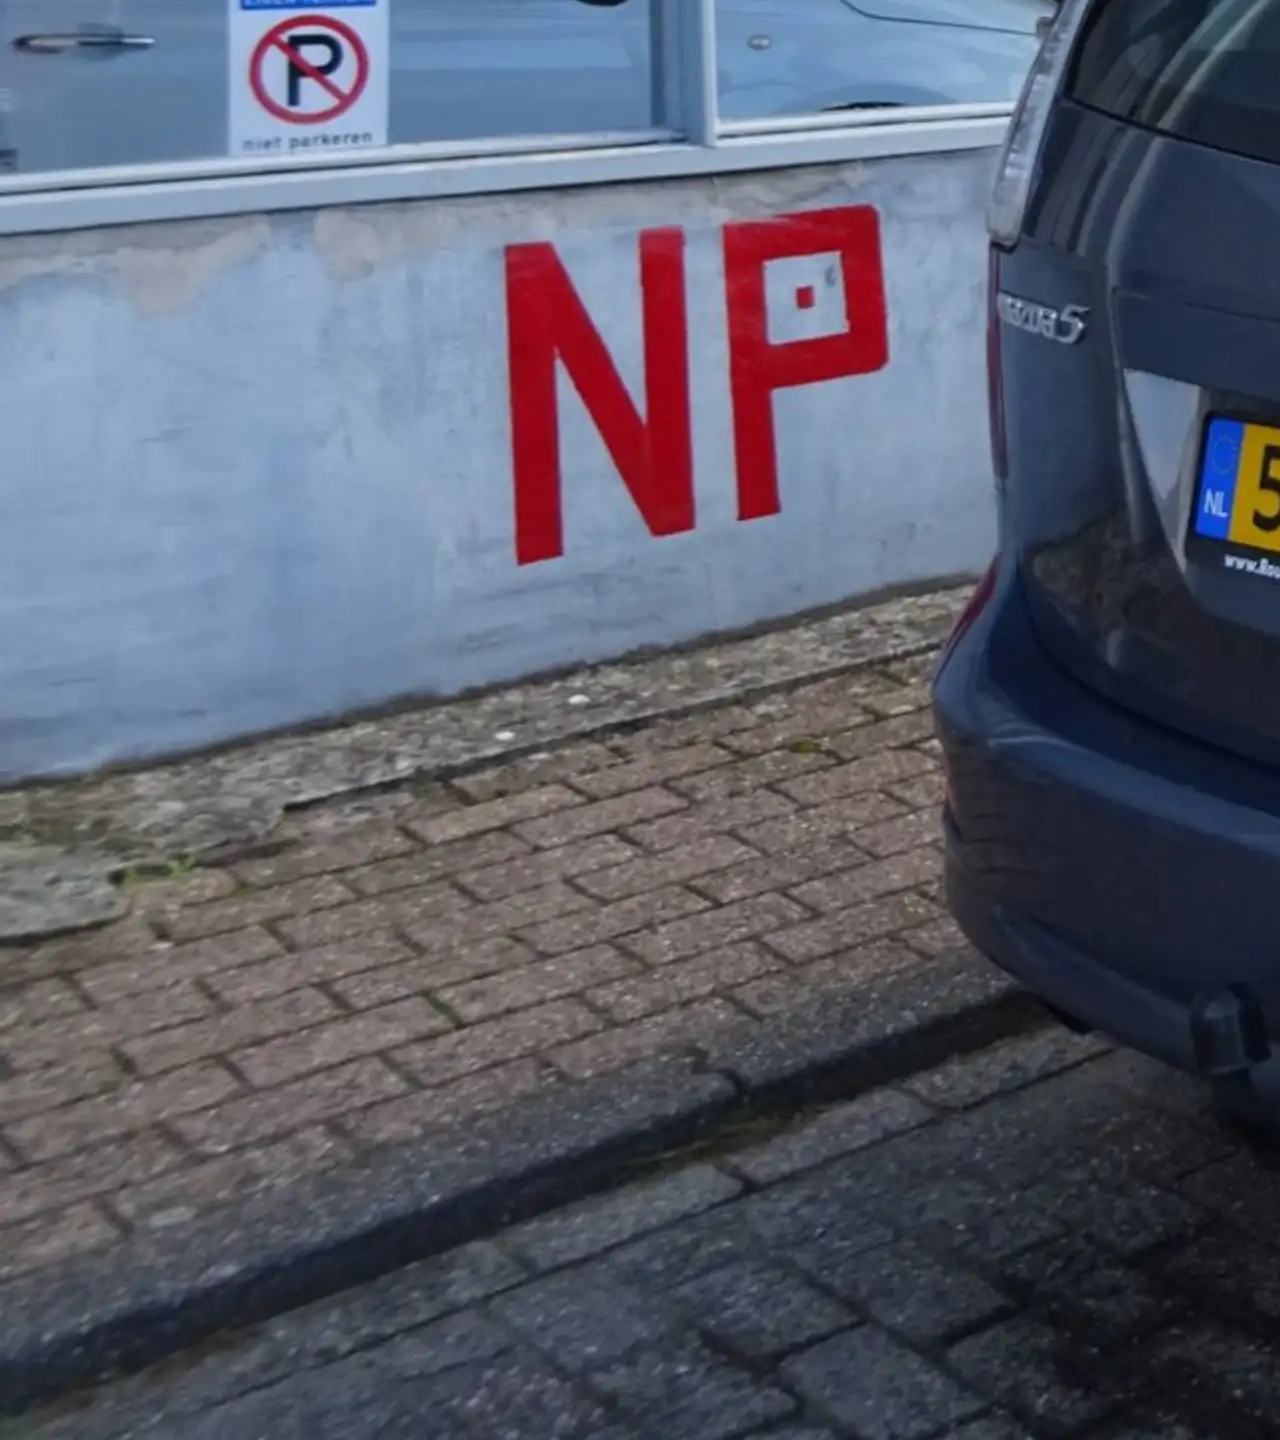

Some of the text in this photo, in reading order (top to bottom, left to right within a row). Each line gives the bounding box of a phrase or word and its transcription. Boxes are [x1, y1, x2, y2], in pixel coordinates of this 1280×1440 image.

[242, 131, 373, 155] niet parkeren
[503, 203, 890, 567] NP
[1203, 489, 1230, 519] NL
